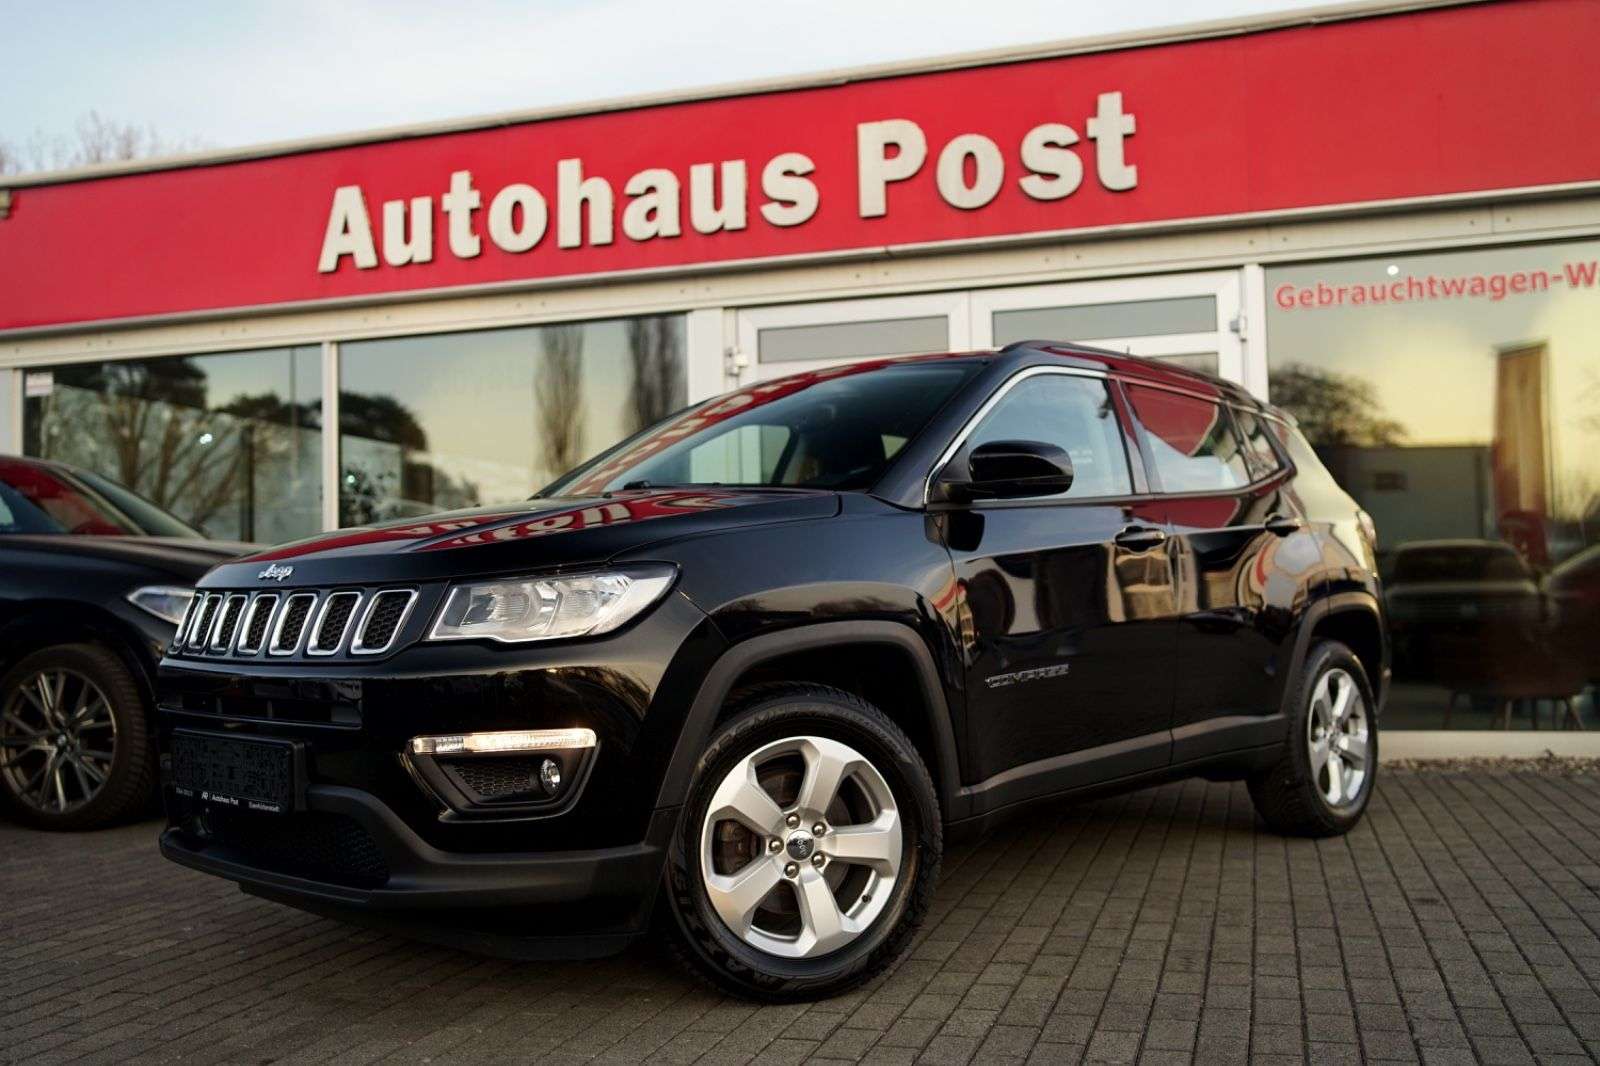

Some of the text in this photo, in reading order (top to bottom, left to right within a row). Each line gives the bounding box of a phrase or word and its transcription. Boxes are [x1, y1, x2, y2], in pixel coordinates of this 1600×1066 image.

[318, 91, 1138, 273] Autohaus Post
[1275, 261, 1598, 310] Gebrauchtwagen-W
[258, 563, 294, 581] Jeep
